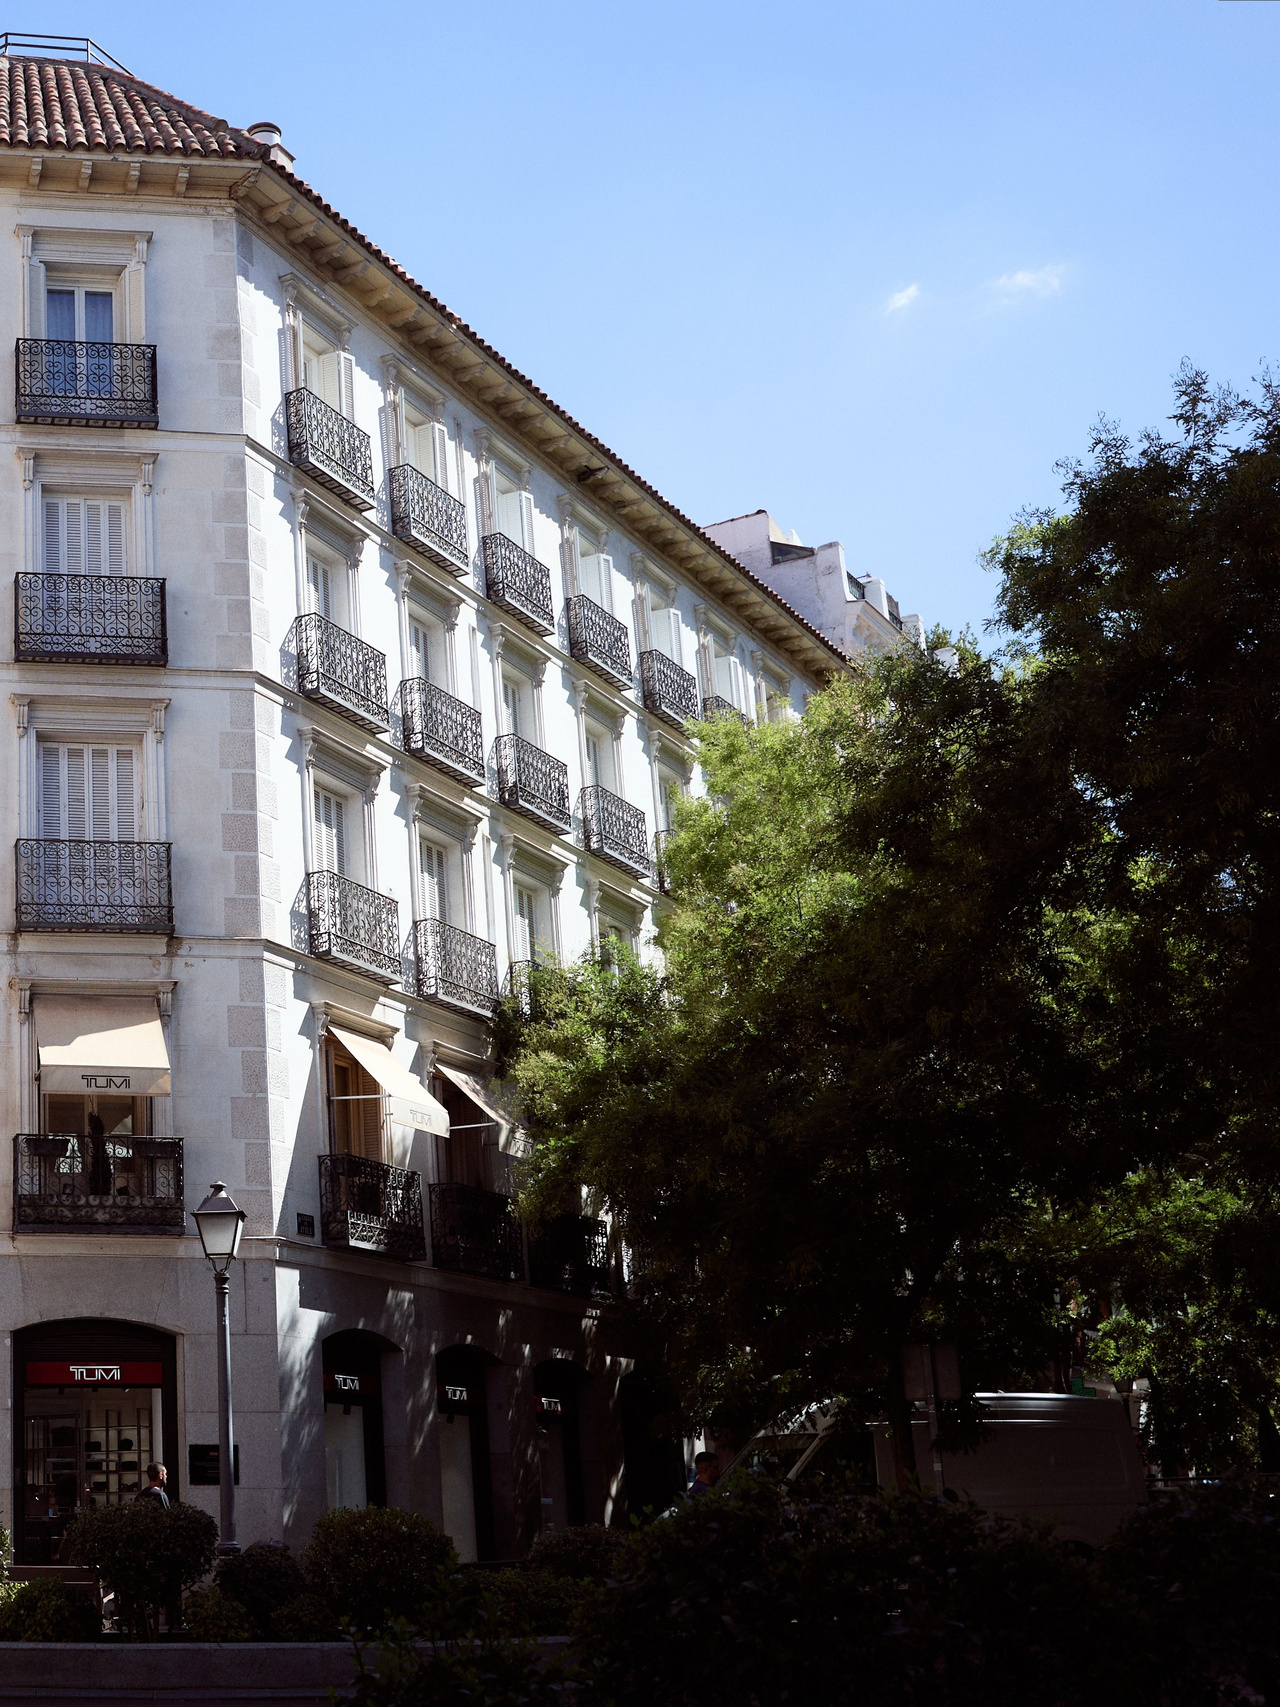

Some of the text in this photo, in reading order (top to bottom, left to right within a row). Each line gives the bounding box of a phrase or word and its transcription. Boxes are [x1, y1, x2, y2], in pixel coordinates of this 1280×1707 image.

[81, 1074, 130, 1090] TUMI
[409, 1109, 432, 1128] TUMI
[69, 1365, 121, 1381] TUMI
[334, 1374, 360, 1391] TUMI
[445, 1386, 467, 1401] TUMI
[541, 1397, 562, 1412] TUMI
